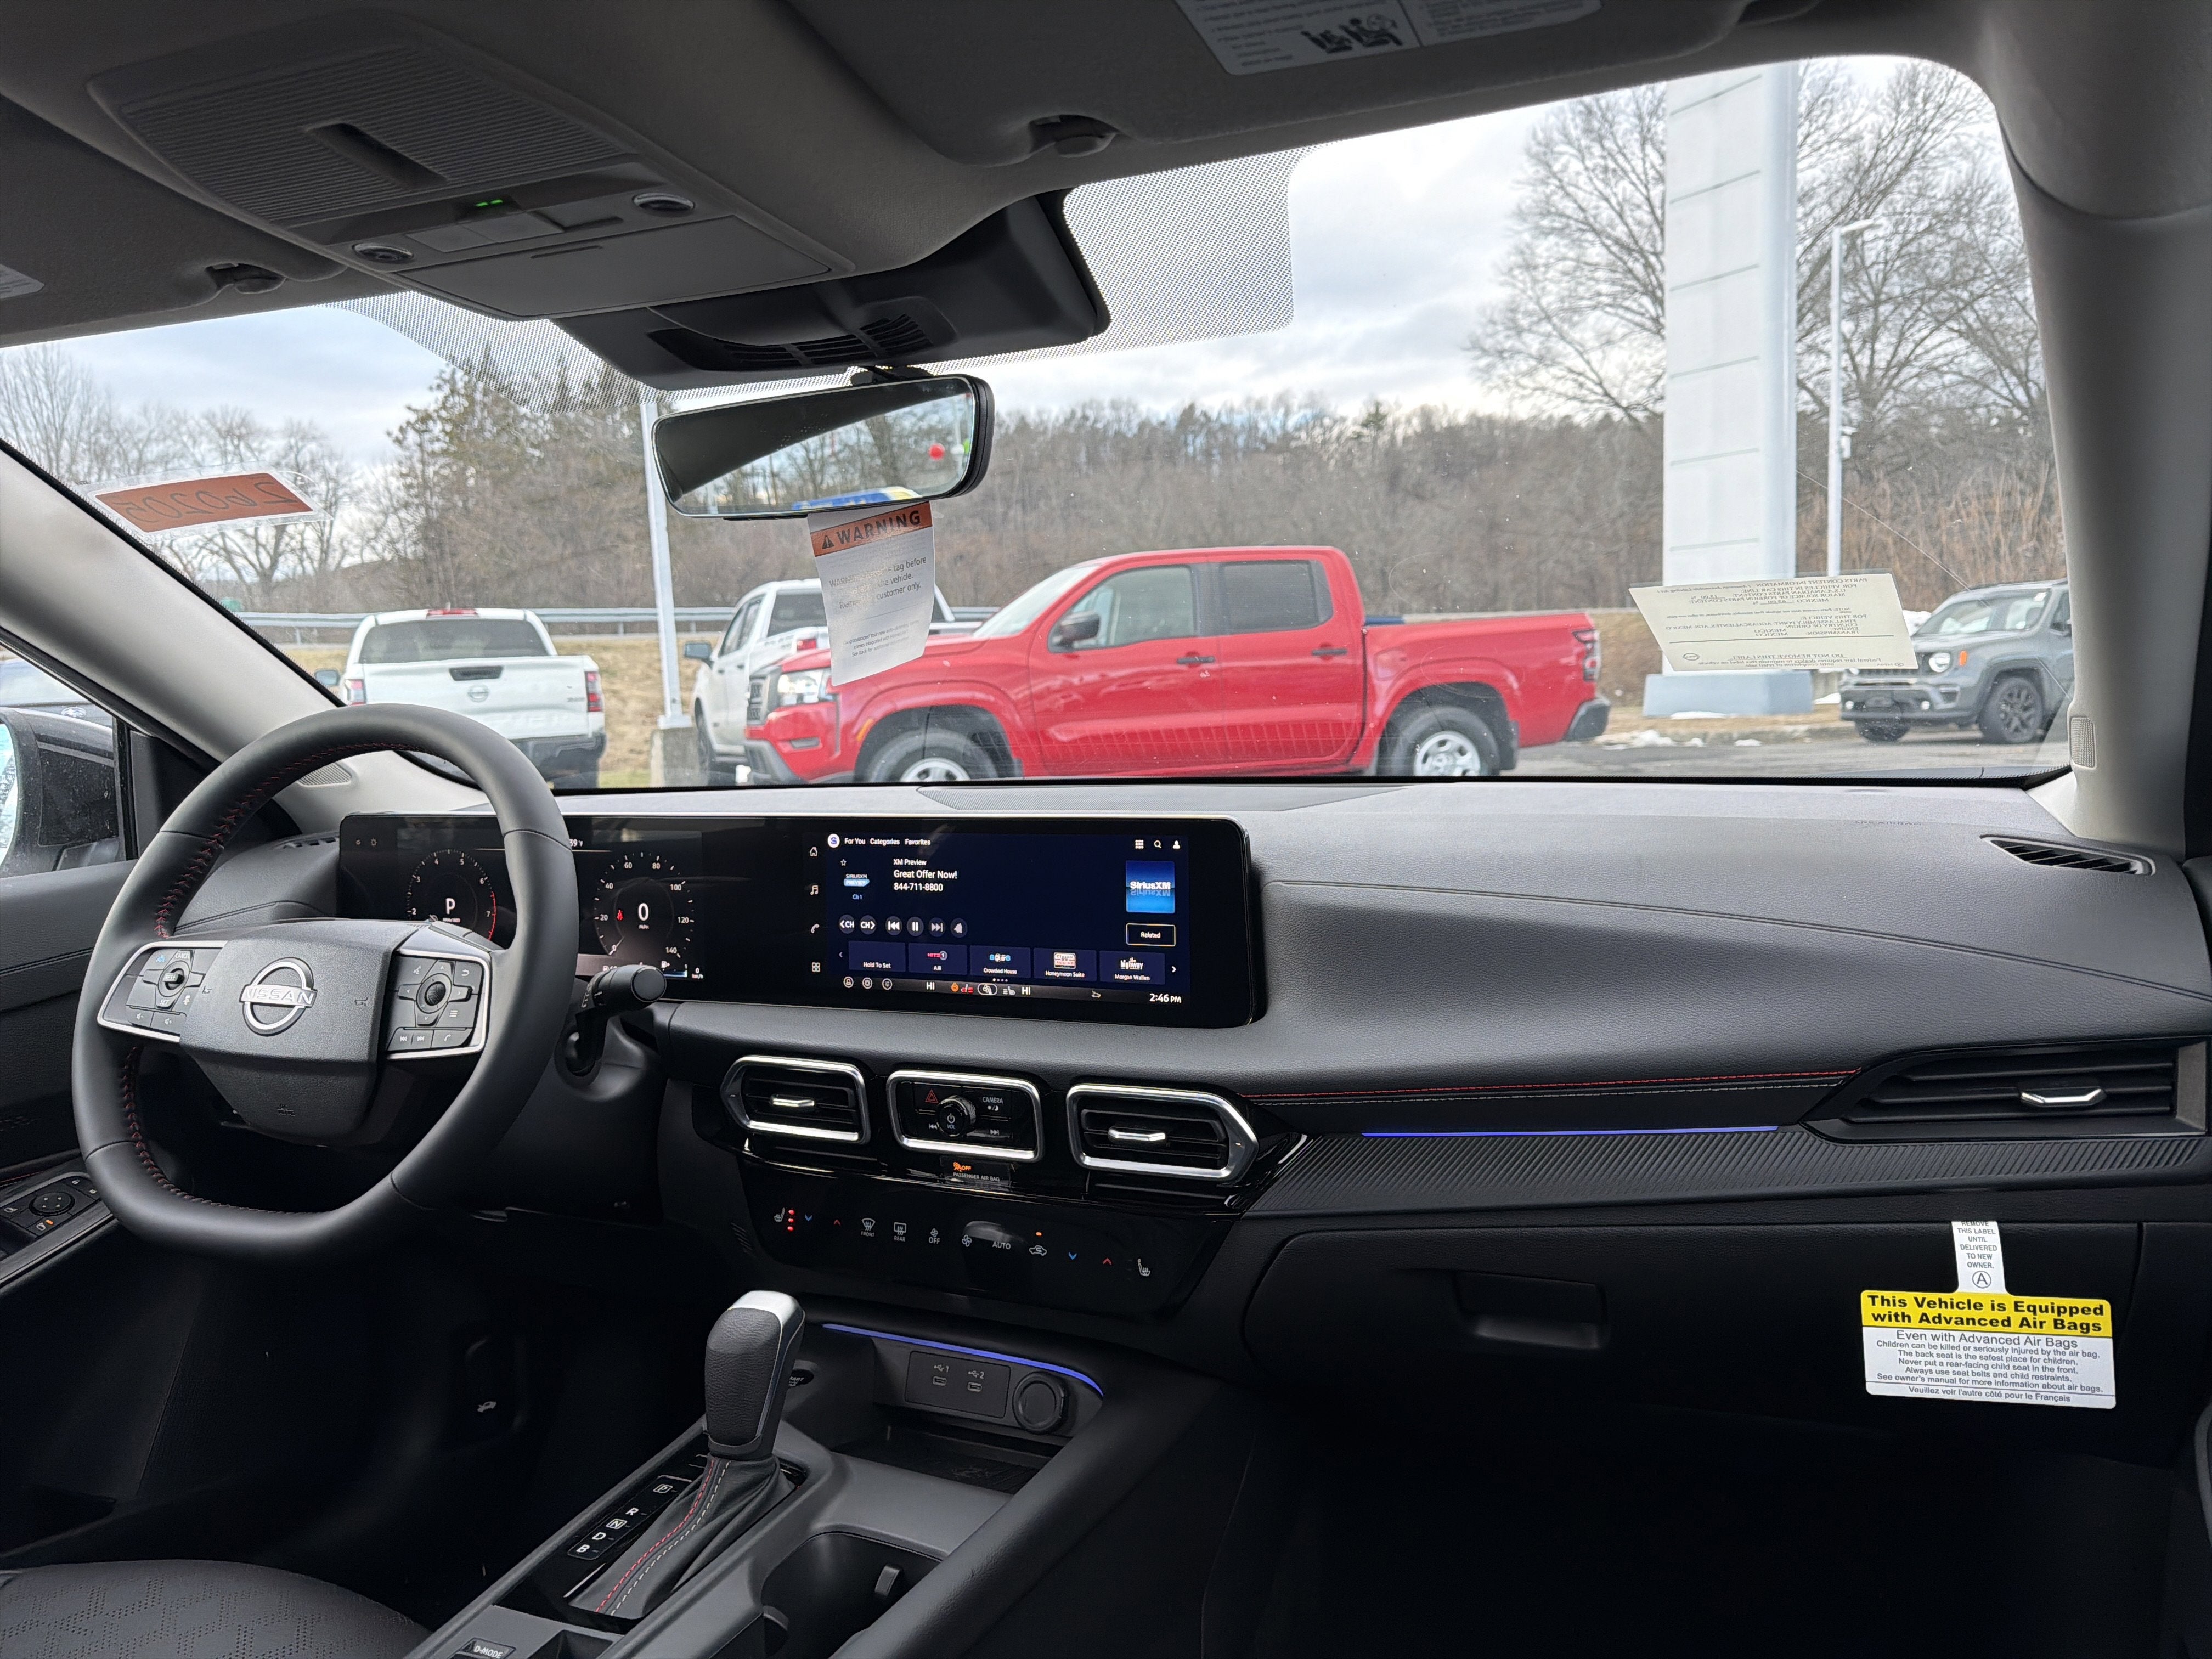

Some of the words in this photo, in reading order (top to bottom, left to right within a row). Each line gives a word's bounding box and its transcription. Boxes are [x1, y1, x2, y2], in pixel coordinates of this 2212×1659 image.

[836, 510, 921, 545] WARNING
[894, 563, 904, 572] tag
[906, 556, 927, 568] before
[890, 573, 913, 584] vehicle.
[876, 586, 906, 600] customer
[907, 582, 921, 591] only.
[894, 870, 914, 878] Great
[917, 870, 935, 879] Offer
[937, 871, 957, 879] Now!
[894, 883, 943, 891] 844-711-8800
[1130, 881, 1171, 889] SiriusXM
[445, 898, 455, 914] P
[638, 903, 648, 921] 0
[1120, 960, 1143, 970] highway
[246, 988, 314, 1005] NISSAN
[1150, 994, 1169, 1002] 2:46
[1867, 1295, 1907, 1307] This
[1914, 1297, 1983, 1310] Vehicle
[1990, 1300, 2006, 1312] is
[2014, 1301, 2103, 1317] Equipped
[1871, 1311, 1911, 1323] with
[1918, 1313, 2011, 1328] Advanced
[2019, 1317, 2046, 1329] Air
[2053, 1318, 2102, 1334] Bags
[1897, 1330, 1927, 1340] Even
[1931, 1333, 1955, 1342] with
[1959, 1333, 2020, 1345] Advanced
[2024, 1337, 2041, 1346] Air
[2046, 1338, 2078, 1350] Bags
[1877, 1340, 1909, 1348] Children
[2082, 1351, 2100, 1359] bag.
[2006, 1355, 2027, 1363] place
[1905, 1367, 1933, 1375] Always
[1946, 1362, 1989, 1370] rear-facing
[1995, 1380, 2039, 1389] information
[2080, 1385, 2103, 1393] bags.
[1909, 1386, 1939, 1394] Veuillez
[2036, 1393, 2070, 1403] Français
[625, 1508, 639, 1516] R
[592, 1532, 606, 1541] D
[576, 1544, 590, 1553] B
[473, 1645, 503, 1658] D-MODE
